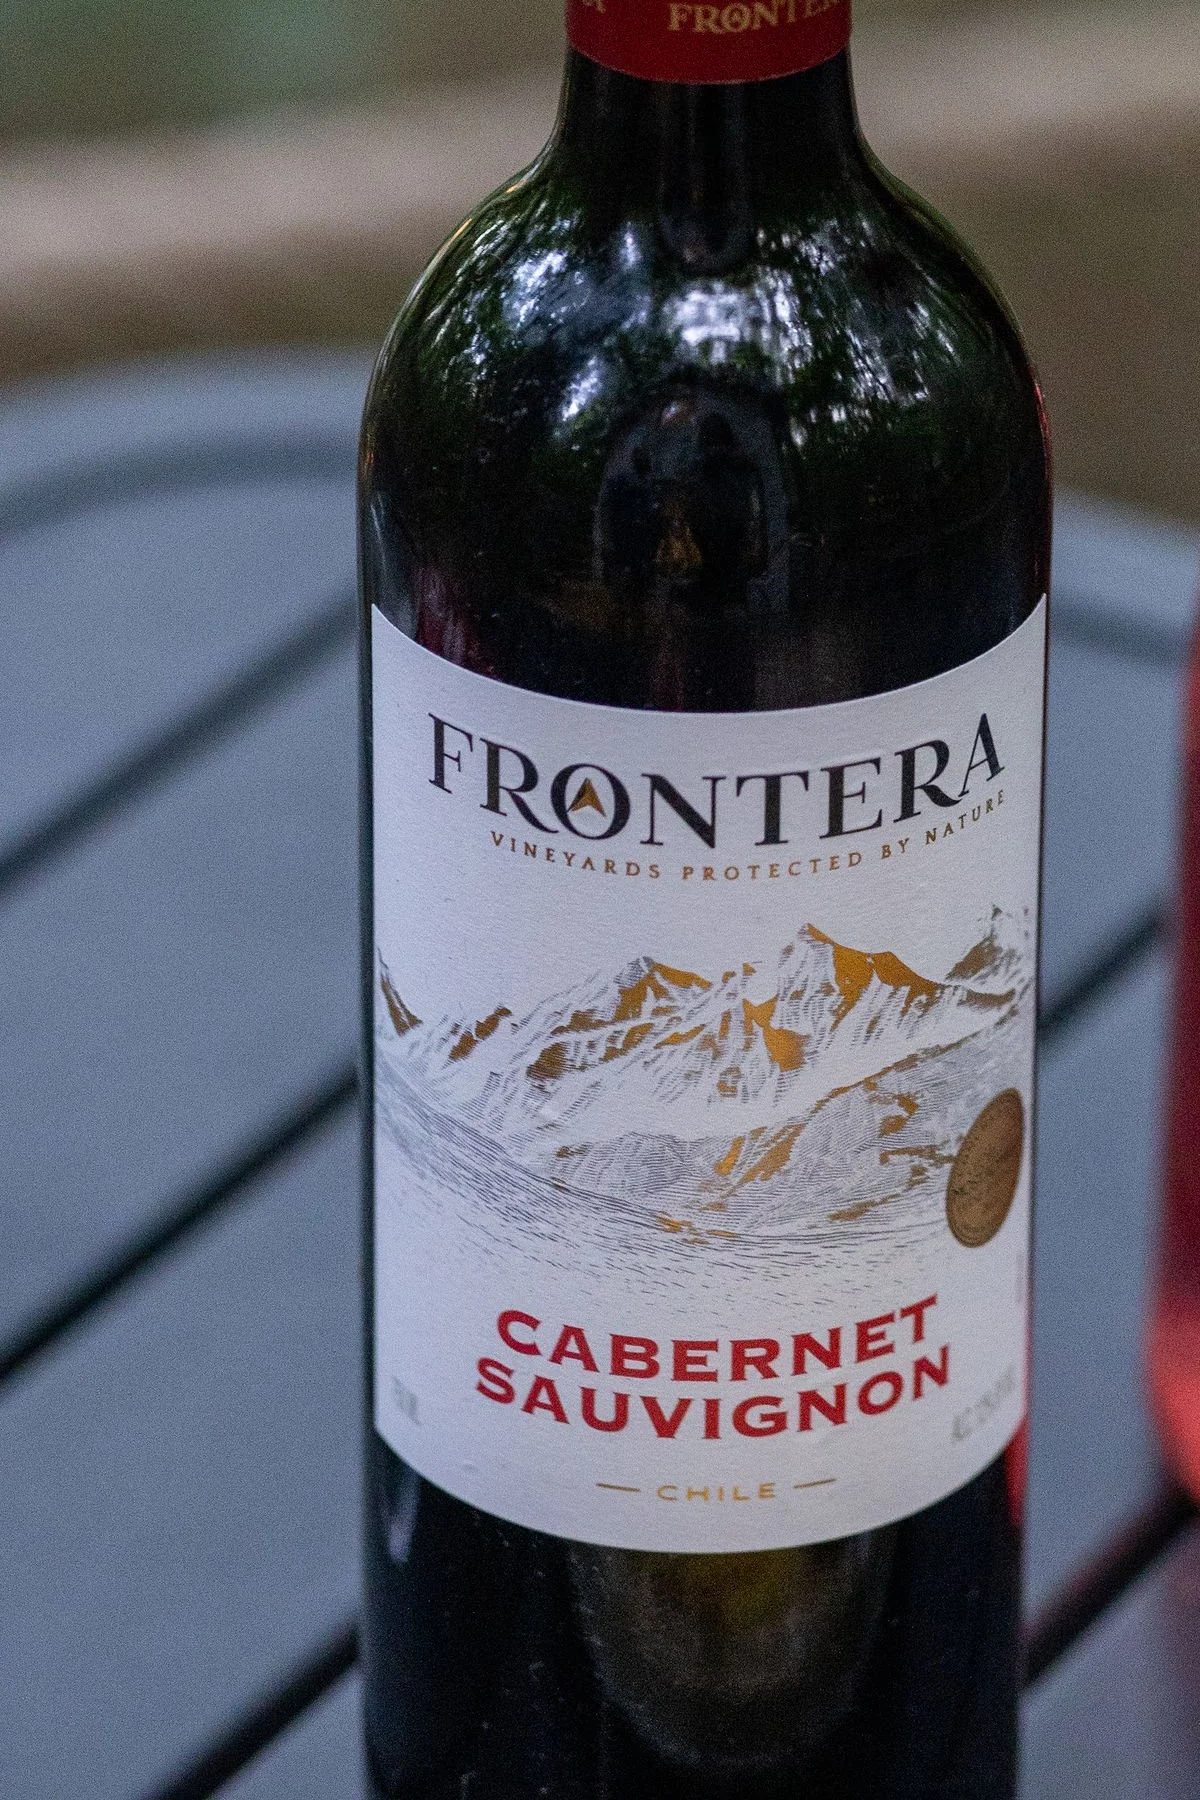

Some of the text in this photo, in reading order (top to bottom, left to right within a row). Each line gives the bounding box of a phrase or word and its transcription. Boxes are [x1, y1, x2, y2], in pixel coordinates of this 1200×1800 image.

[427, 712, 1006, 850] FRONTERA
[490, 788, 1005, 882] VINEYARDS PROTECTED BY NATURE
[495, 1293, 939, 1384] CABERNET
[474, 1344, 952, 1441] SAUVIGNON
[656, 1481, 778, 1503] CHILE
